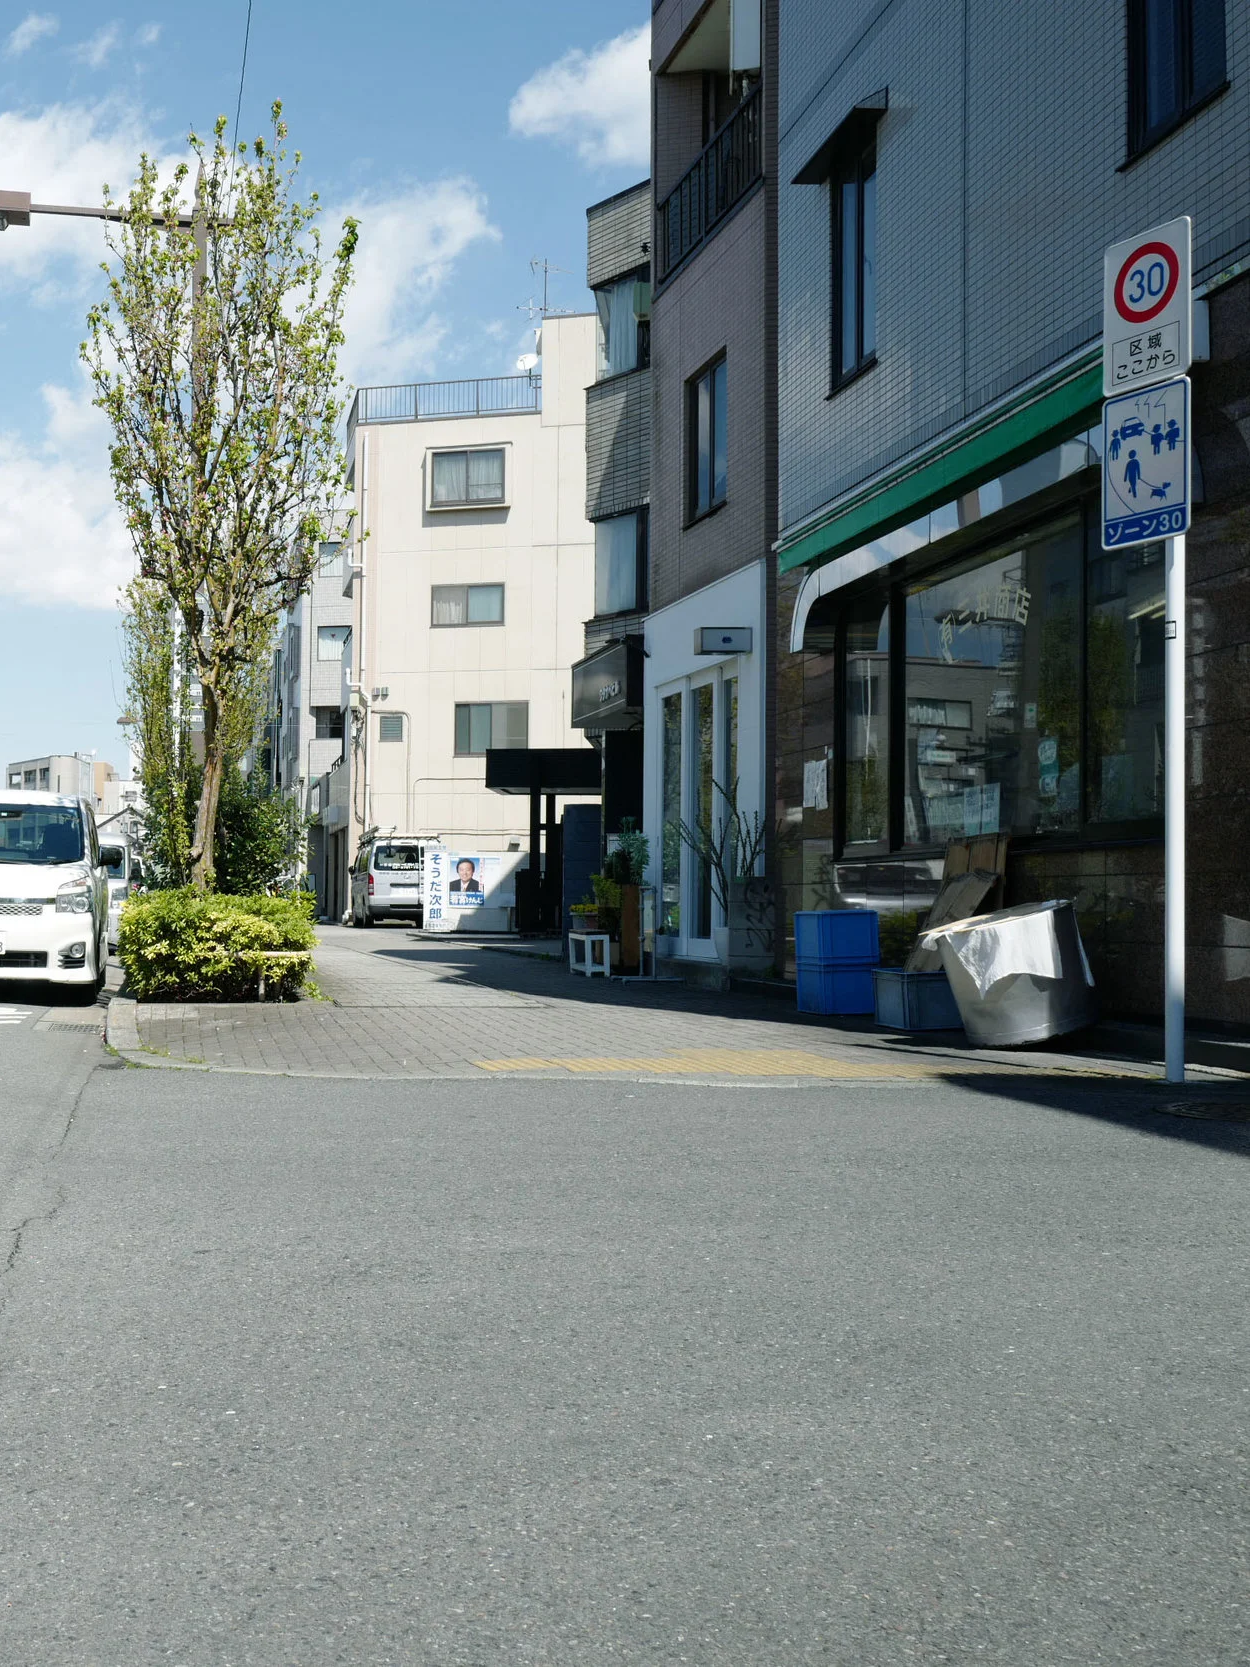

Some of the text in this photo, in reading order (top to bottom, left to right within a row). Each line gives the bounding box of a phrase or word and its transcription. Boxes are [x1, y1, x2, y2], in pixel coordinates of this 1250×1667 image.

[1129, 262, 1164, 303] 30
[1130, 332, 1162, 356] 区域
[1117, 350, 1175, 379] ここから
[1109, 511, 1182, 543] ゾーン30
[430, 853, 442, 919] そうだ次郎
